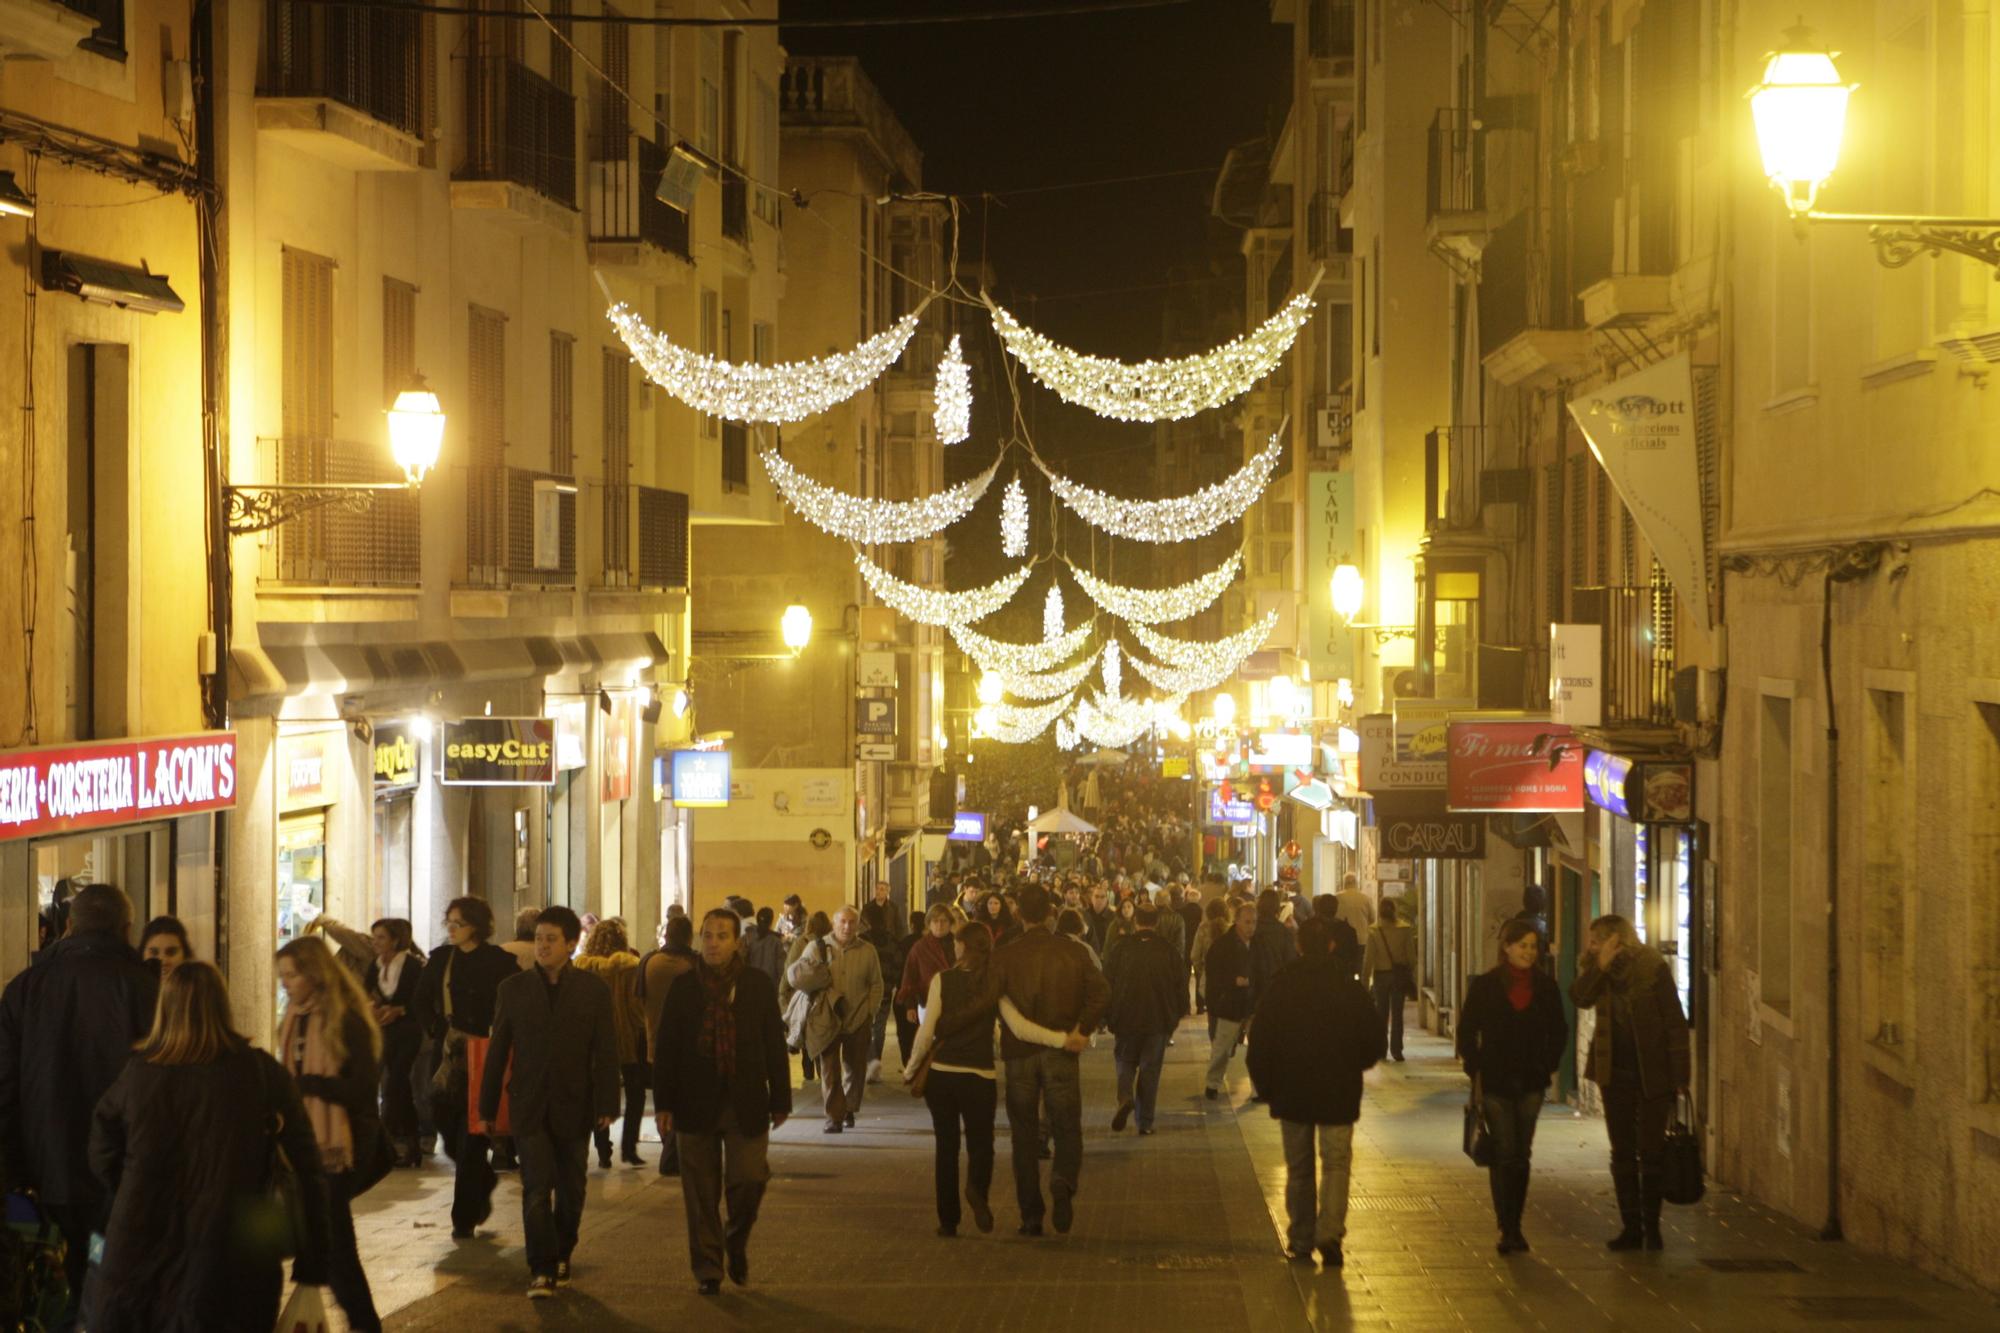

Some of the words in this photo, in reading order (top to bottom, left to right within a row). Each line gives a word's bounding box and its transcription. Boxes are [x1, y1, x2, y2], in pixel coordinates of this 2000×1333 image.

[447, 740, 550, 762] easyCut
[0, 766, 39, 826] ERIA
[48, 757, 134, 818] CORSETERIA
